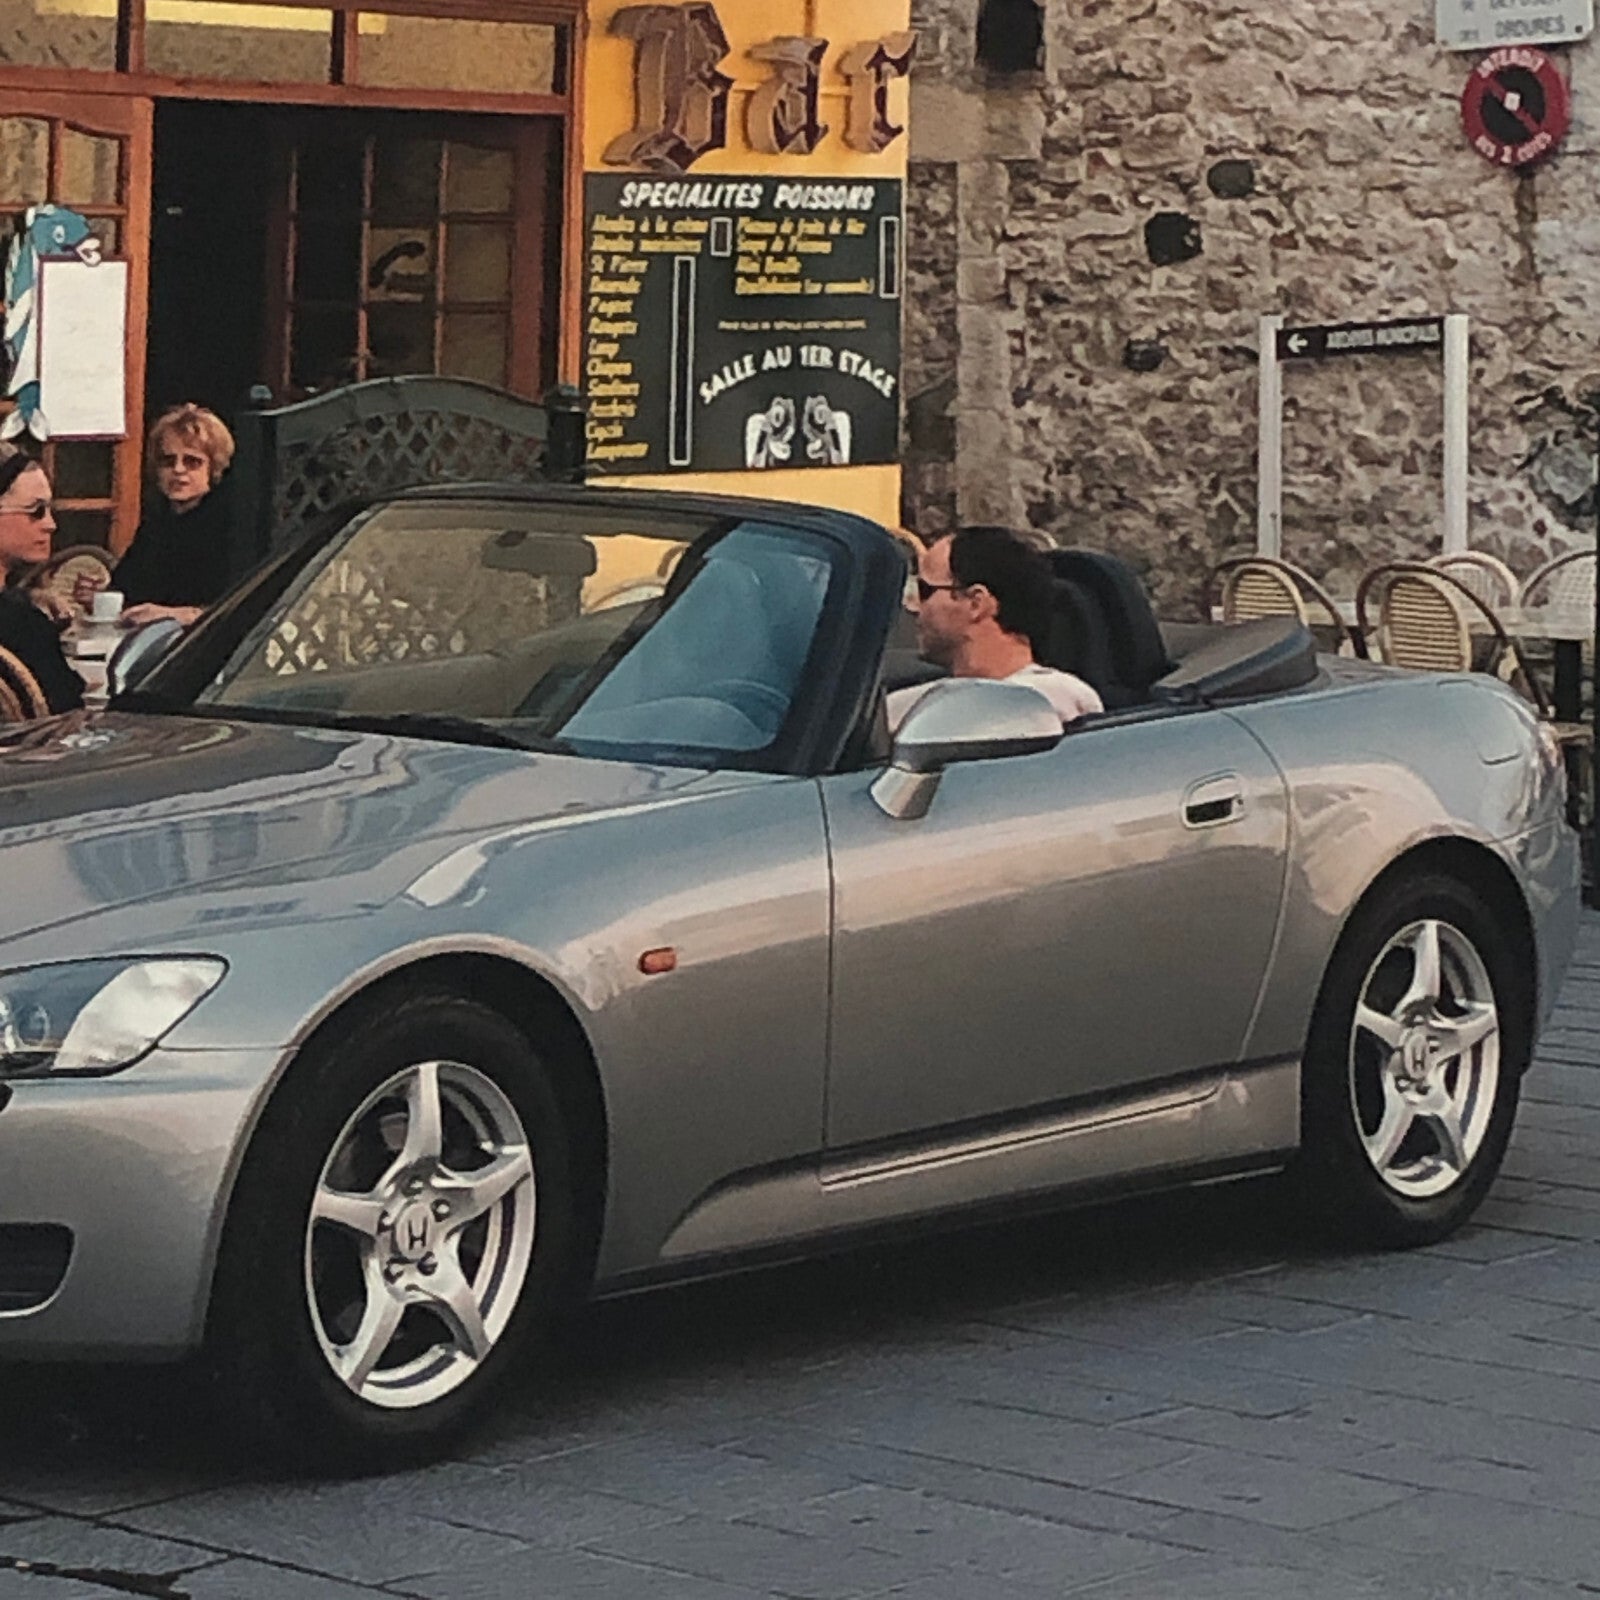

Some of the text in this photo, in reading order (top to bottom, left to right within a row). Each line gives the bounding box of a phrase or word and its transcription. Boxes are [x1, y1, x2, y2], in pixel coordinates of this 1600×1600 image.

[620, 182, 876, 210] SPECIALITES POISSONS
[699, 345, 897, 404] SALLE AU 1ER ETAGE
